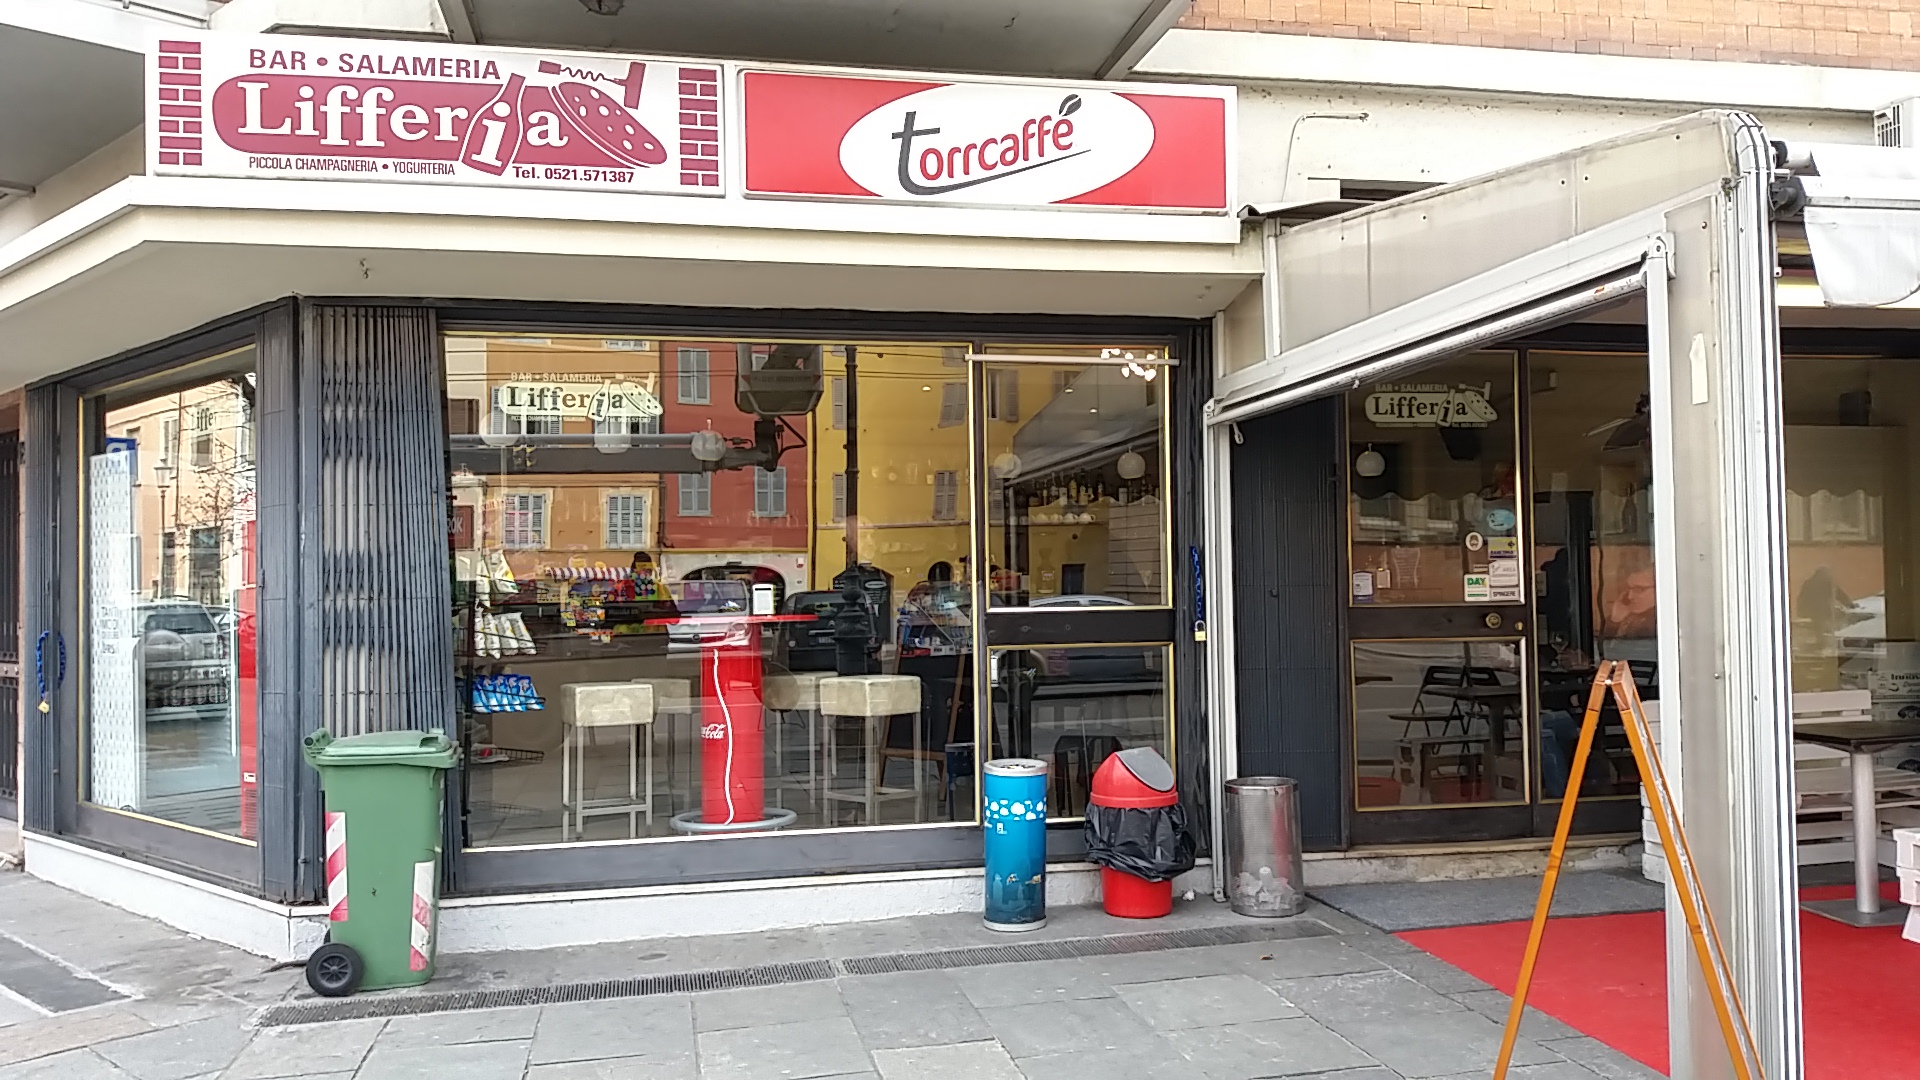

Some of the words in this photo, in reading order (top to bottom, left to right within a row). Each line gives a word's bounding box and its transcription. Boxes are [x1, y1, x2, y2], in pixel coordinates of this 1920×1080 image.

[249, 48, 307, 71] BAR
[338, 52, 501, 80] SALAMERIA
[236, 80, 569, 168] Lifferia
[249, 155, 293, 170] PICCOLA
[295, 157, 379, 173] CHAMPAGNERIA
[392, 160, 456, 176] YOGURTERIA
[512, 165, 540, 180] Tel.
[544, 167, 635, 184] 0521.571387
[510, 372, 533, 382] BAR
[542, 372, 603, 383] SALAMERIA
[1375, 383, 1393, 392] BAR
[1400, 383, 1449, 392] SALAMERIA
[506, 385, 625, 418] Lifferia
[1372, 396, 1468, 424] Lifferia
[1467, 577, 1486, 586] DAY
